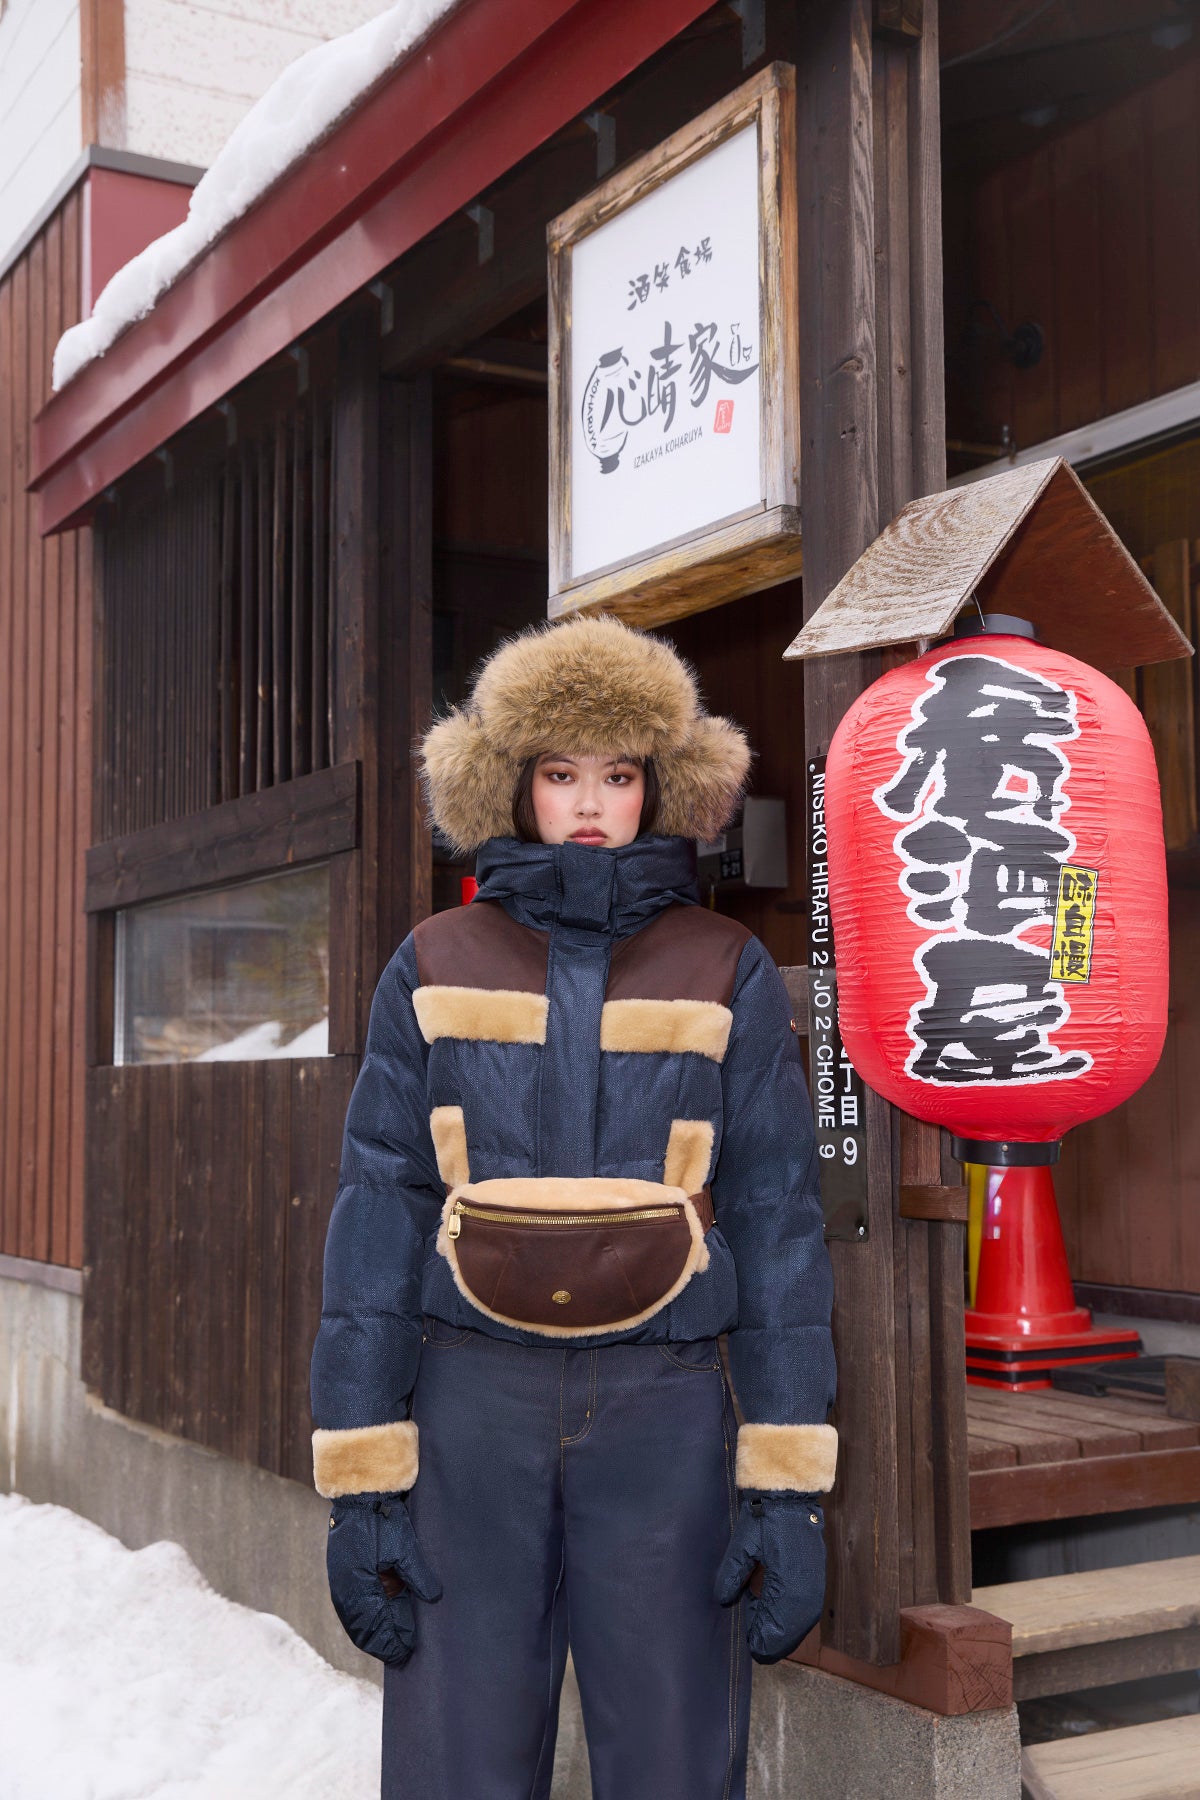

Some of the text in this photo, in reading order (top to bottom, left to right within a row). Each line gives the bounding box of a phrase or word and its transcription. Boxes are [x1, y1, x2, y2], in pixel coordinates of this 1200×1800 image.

[587, 378, 600, 450] KOHARUYA
[633, 426, 703, 469] IZAKAYA KOHARUYA
[812, 773, 828, 855] NISEKO
[811, 862, 829, 943] HIRAFU
[878, 655, 1092, 1084] 居酒屋
[1053, 872, 1092, 978] 味自慢
[819, 1144, 836, 1159] 9
